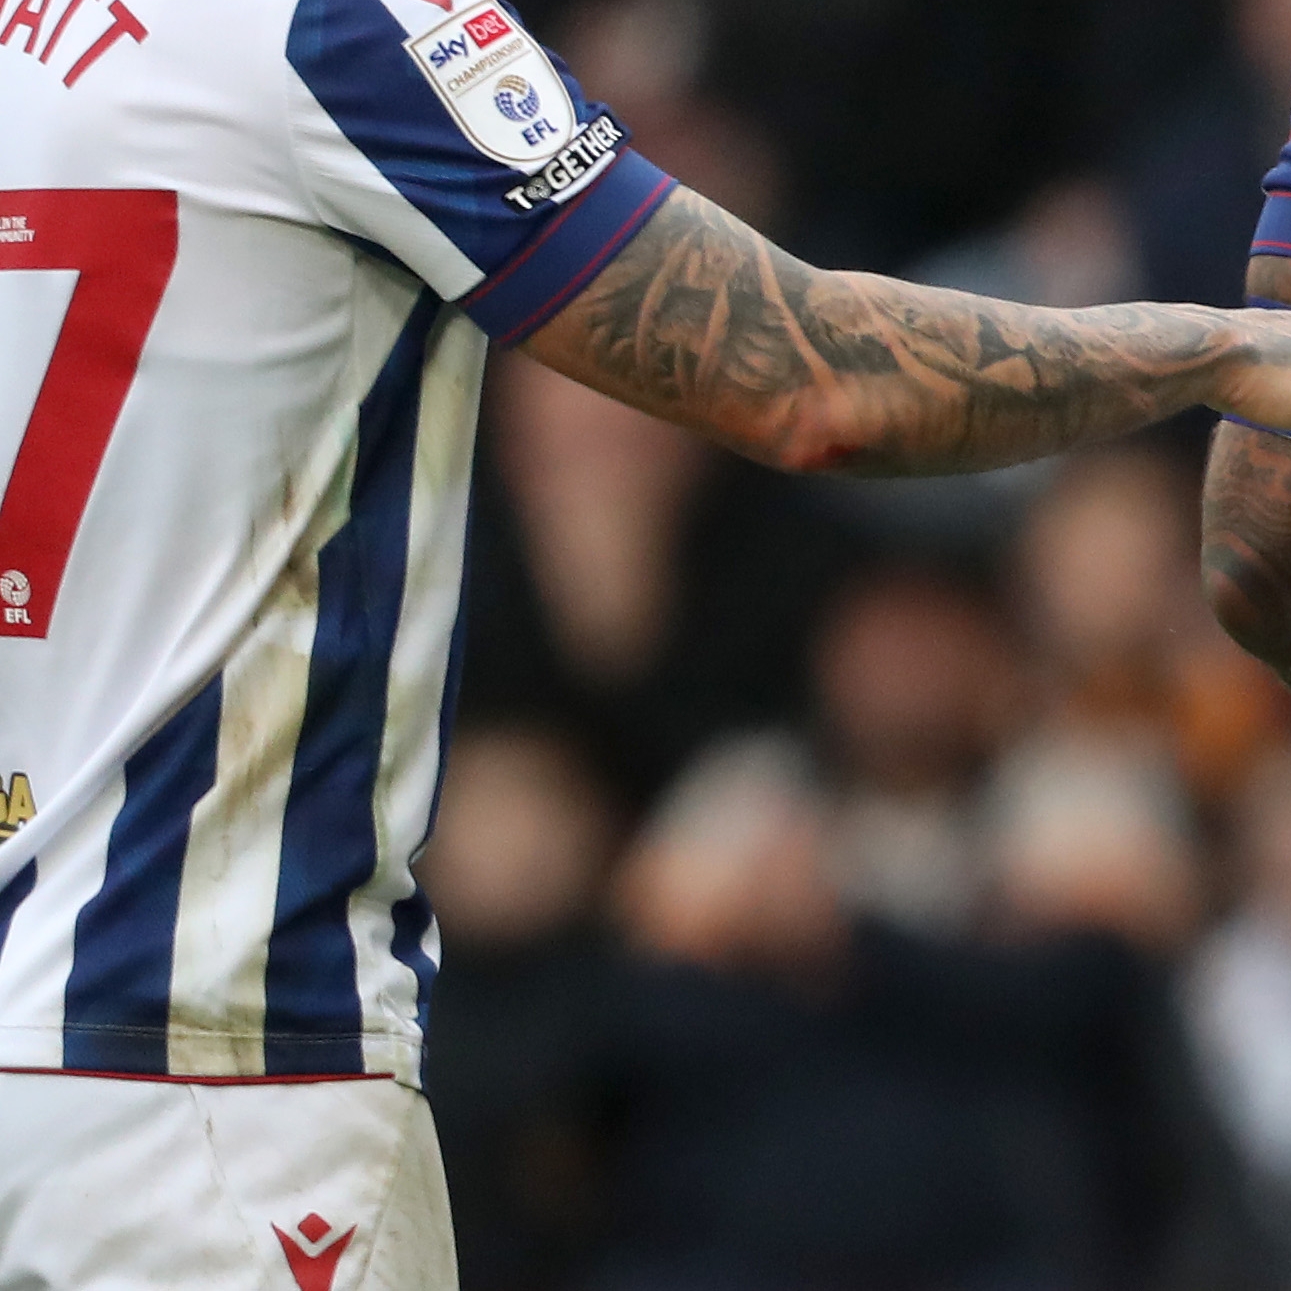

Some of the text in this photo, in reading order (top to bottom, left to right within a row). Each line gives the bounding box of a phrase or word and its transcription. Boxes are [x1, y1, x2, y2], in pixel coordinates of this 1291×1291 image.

[429, 12, 507, 69] sky bet
[446, 36, 526, 93] CHAMPIONSHIP
[521, 117, 559, 147] EFL
[503, 114, 624, 210] TOGETHER
[0, 188, 179, 639] 7
[5, 607, 32, 625] EFL
